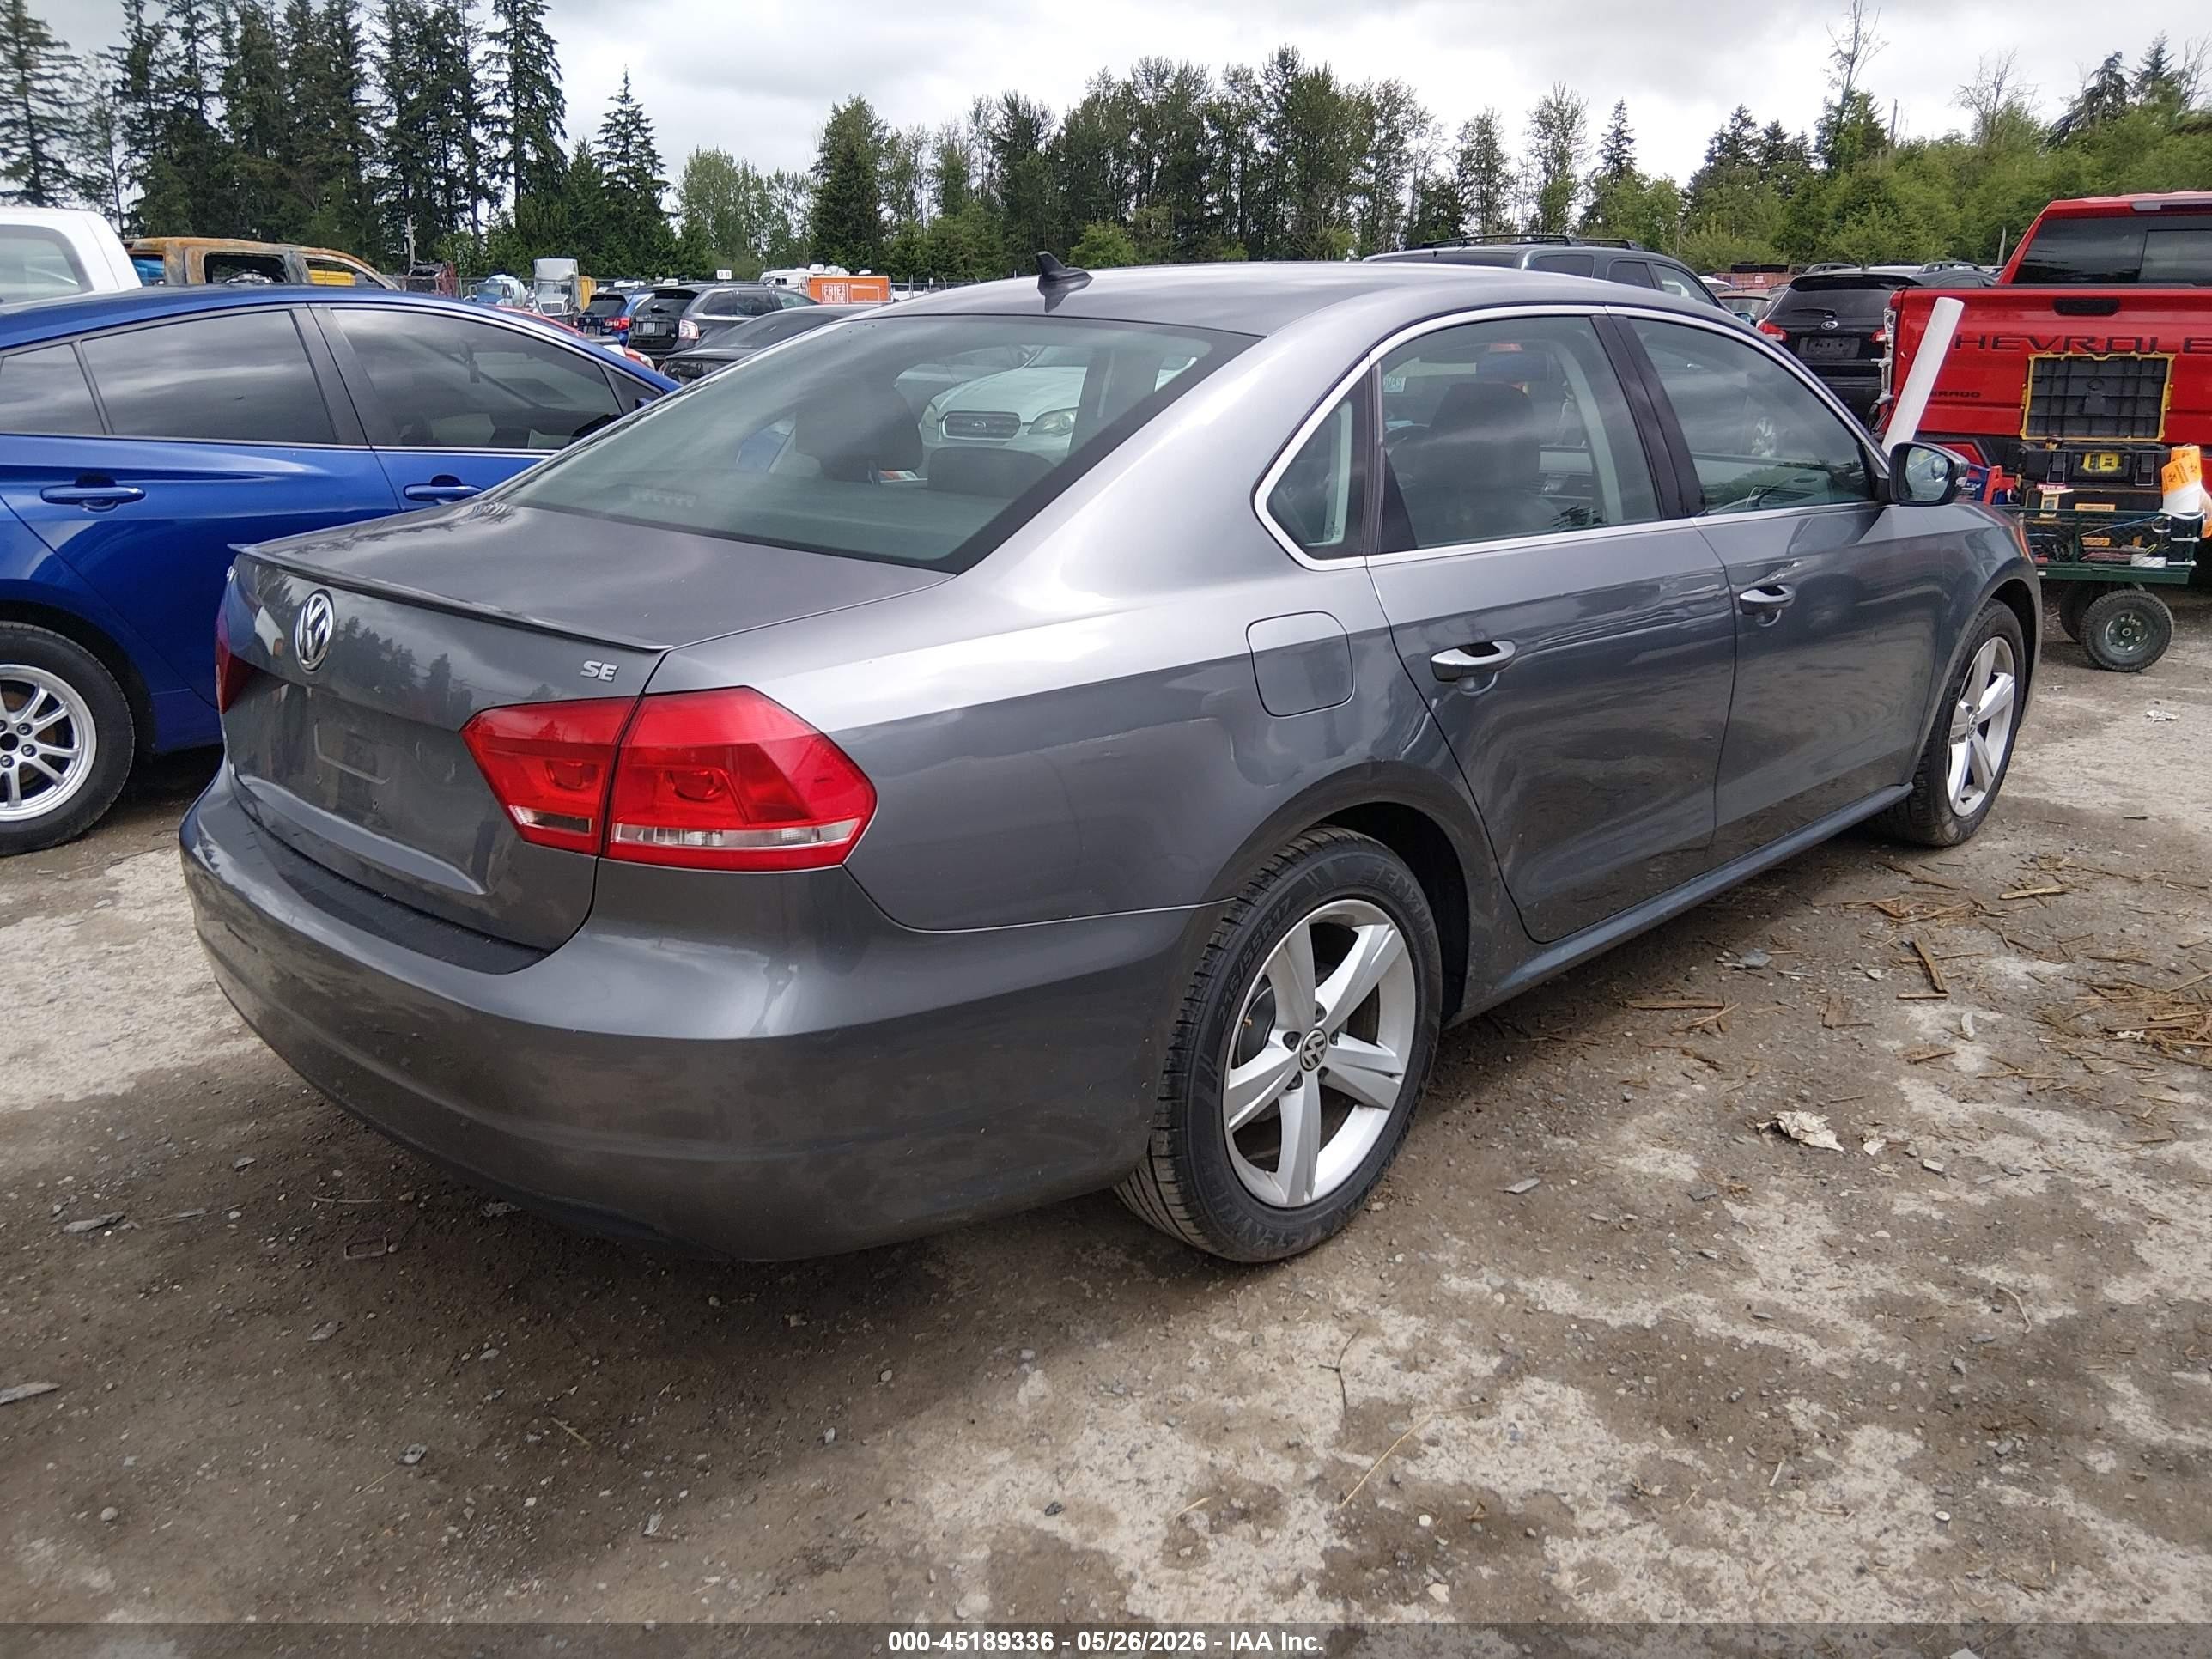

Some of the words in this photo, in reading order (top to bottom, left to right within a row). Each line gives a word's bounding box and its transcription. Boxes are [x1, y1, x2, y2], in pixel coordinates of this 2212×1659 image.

[824, 285, 845, 295] FRIES
[1954, 334, 2212, 354] HEVROLE
[580, 660, 618, 682] SE
